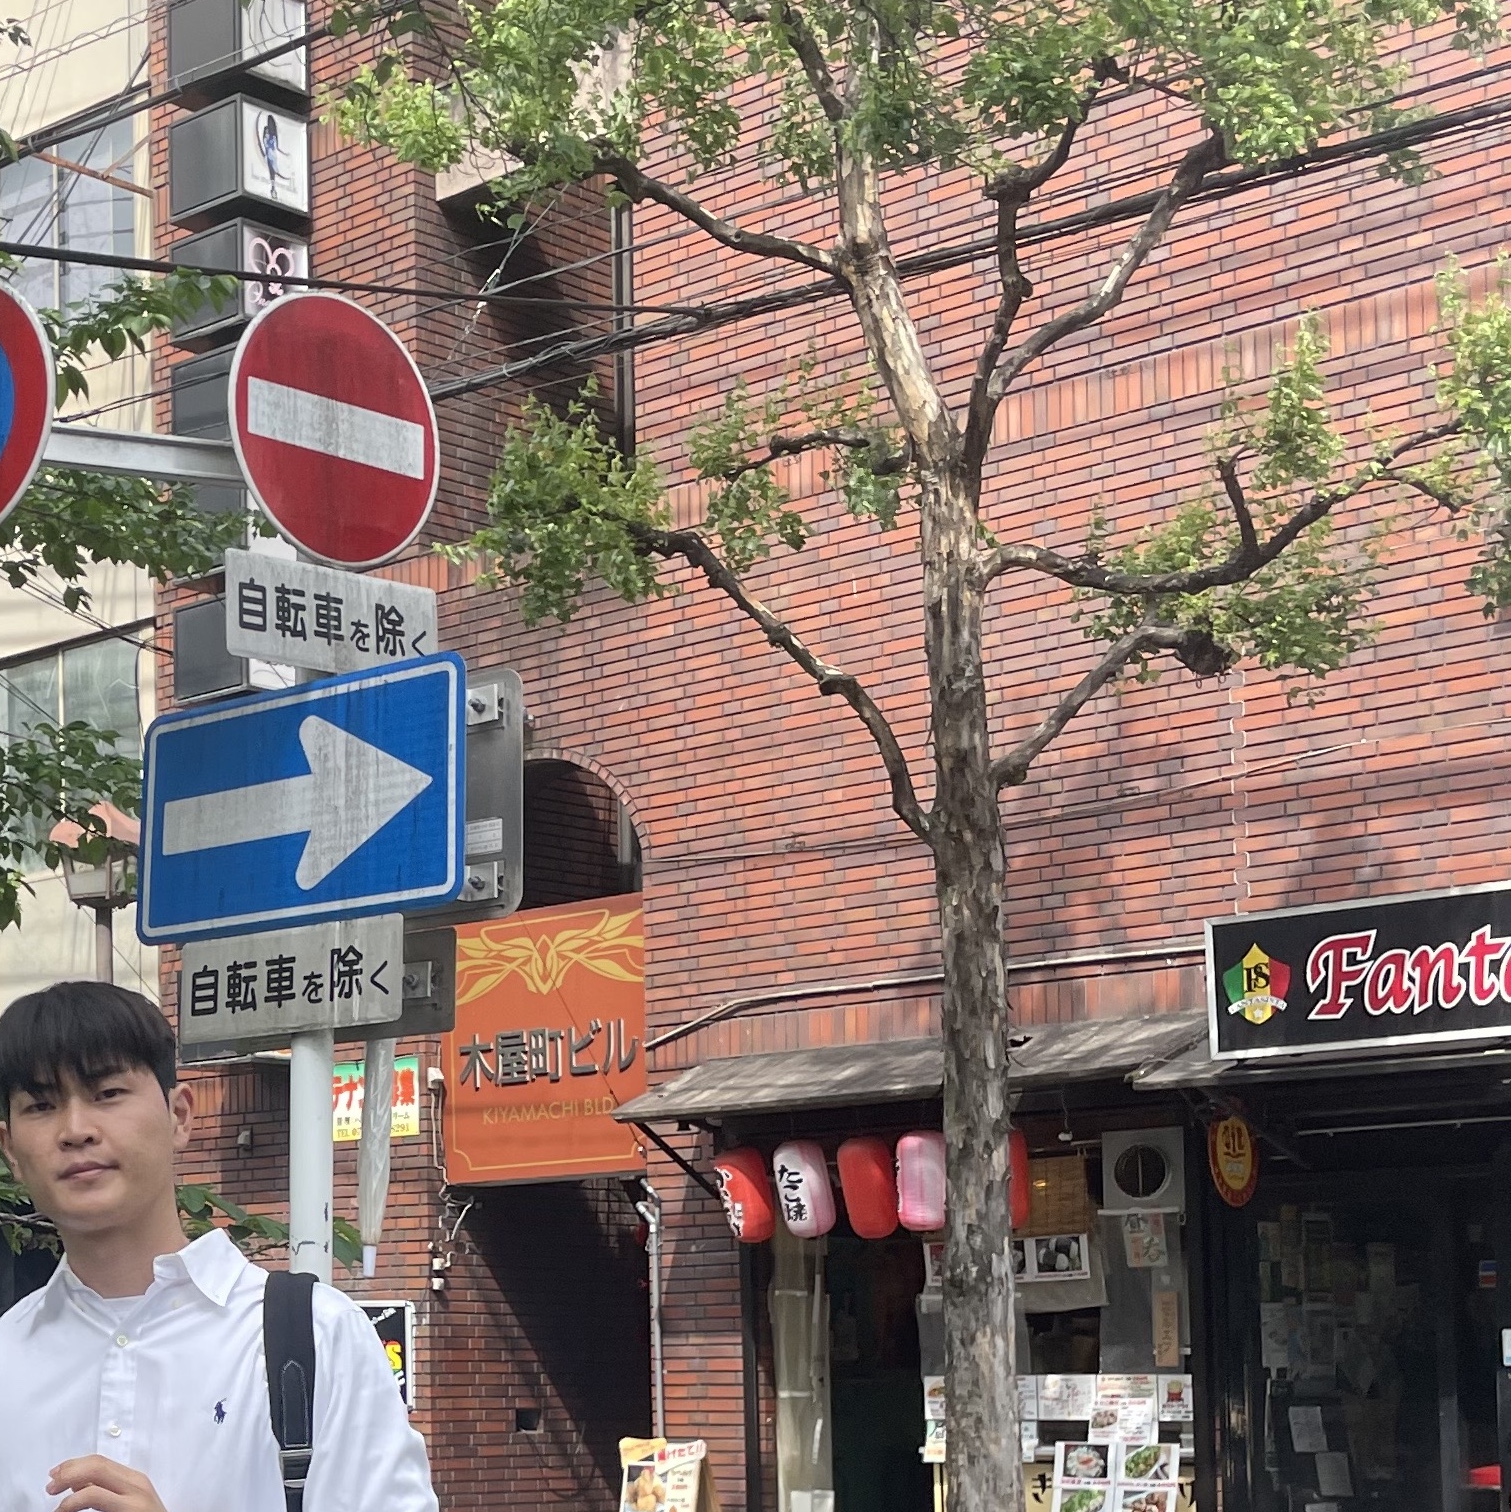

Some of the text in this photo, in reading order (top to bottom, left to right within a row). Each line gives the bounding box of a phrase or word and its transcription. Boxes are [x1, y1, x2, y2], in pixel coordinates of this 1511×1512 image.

[238, 577, 427, 657] 自転車を除く
[190, 944, 390, 1018] 自転車を除く
[459, 1017, 639, 1092] 木屋町ビル
[482, 1100, 579, 1126] KIYAMACHI
[778, 1164, 808, 1222] たこ焼
